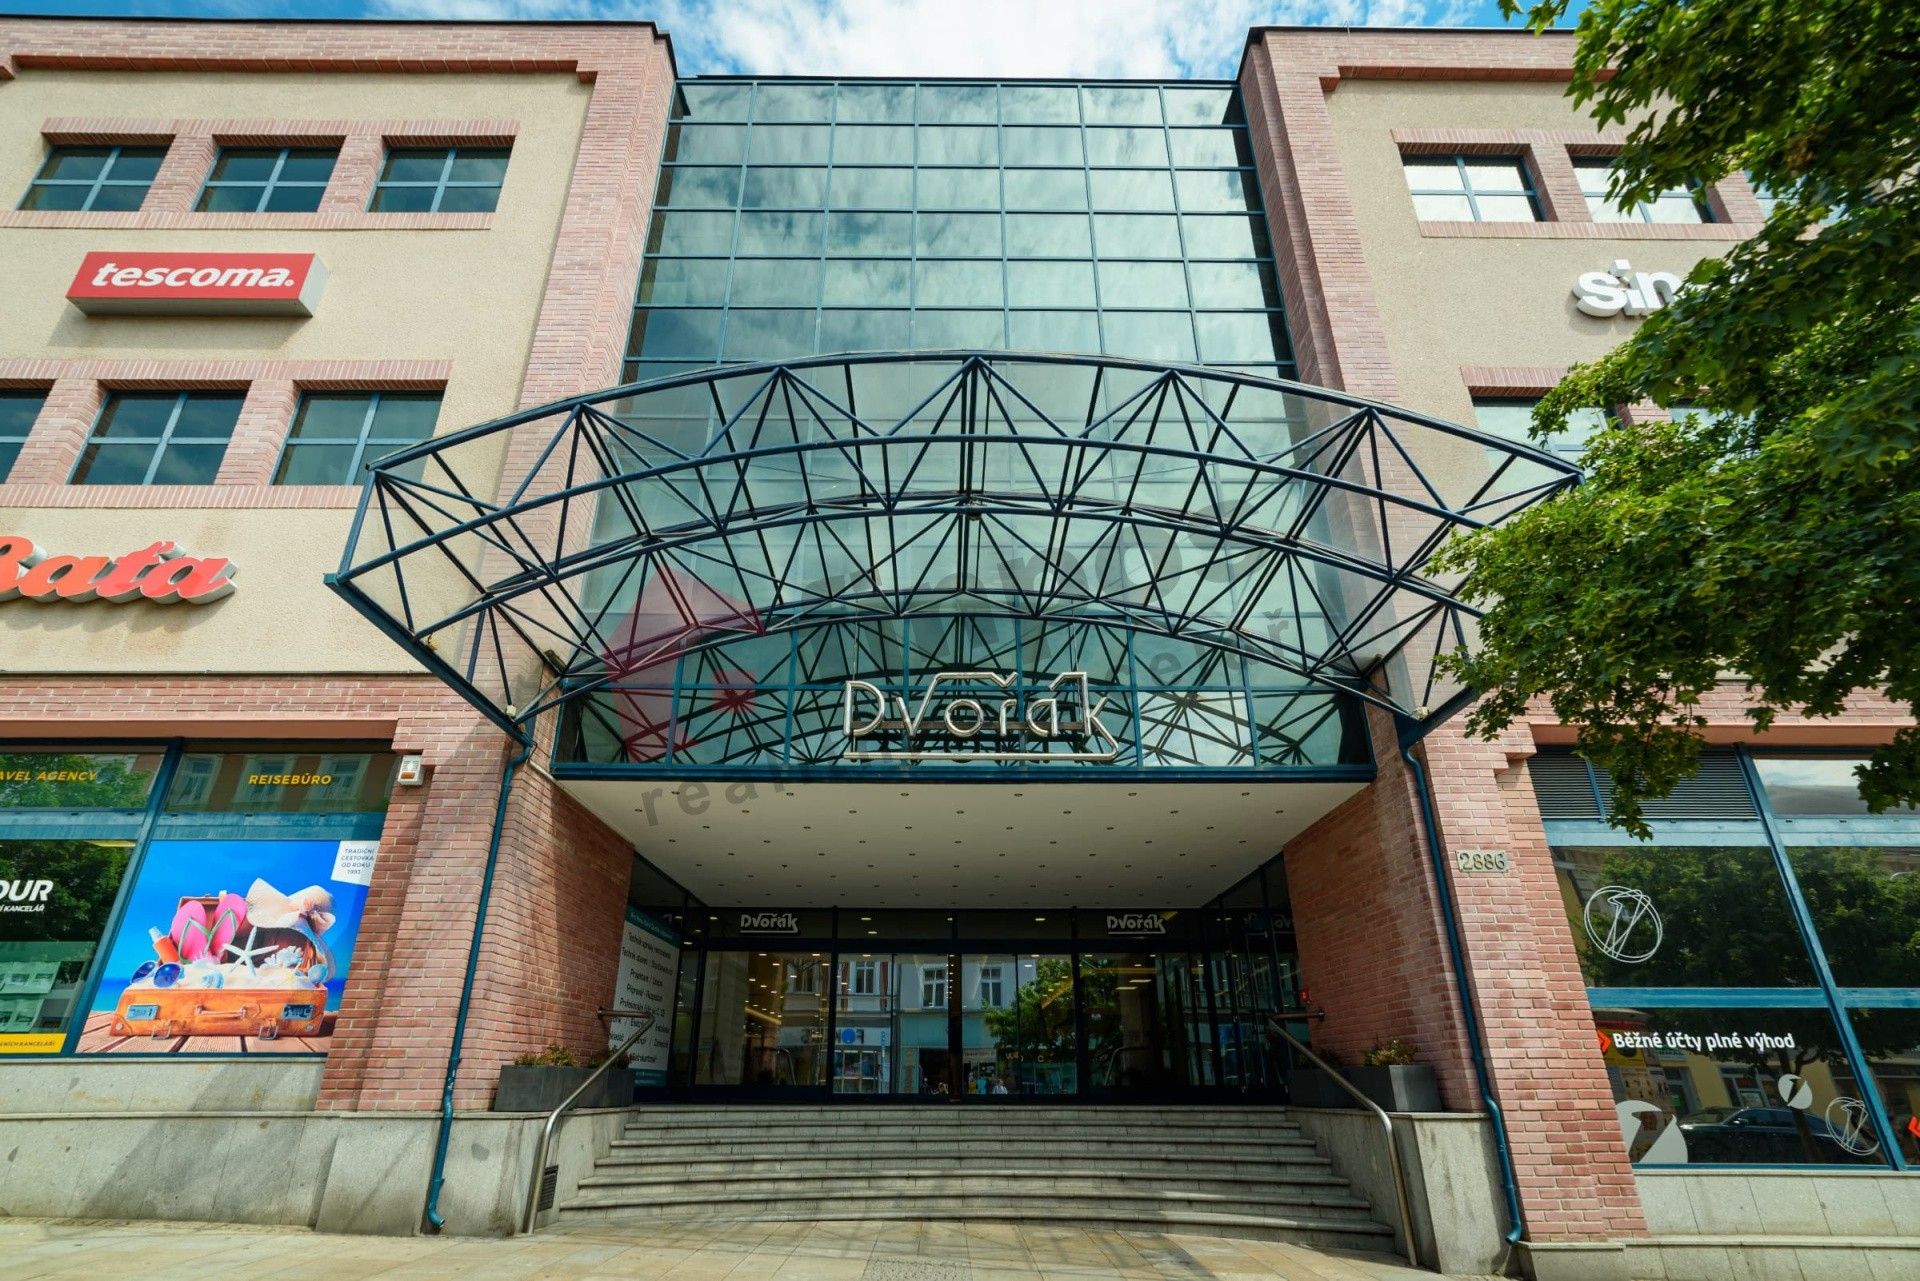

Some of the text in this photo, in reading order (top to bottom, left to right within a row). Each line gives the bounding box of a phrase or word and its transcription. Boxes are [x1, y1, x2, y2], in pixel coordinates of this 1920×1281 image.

[843, 672, 1118, 760] Dvořák
[36, 771, 98, 781] AGENCY
[1459, 852, 1505, 870] 2886
[740, 912, 798, 933] Dvořák
[1106, 914, 1166, 934] Dvořák
[1613, 1032, 1796, 1052] Běžné účty plné výhod
